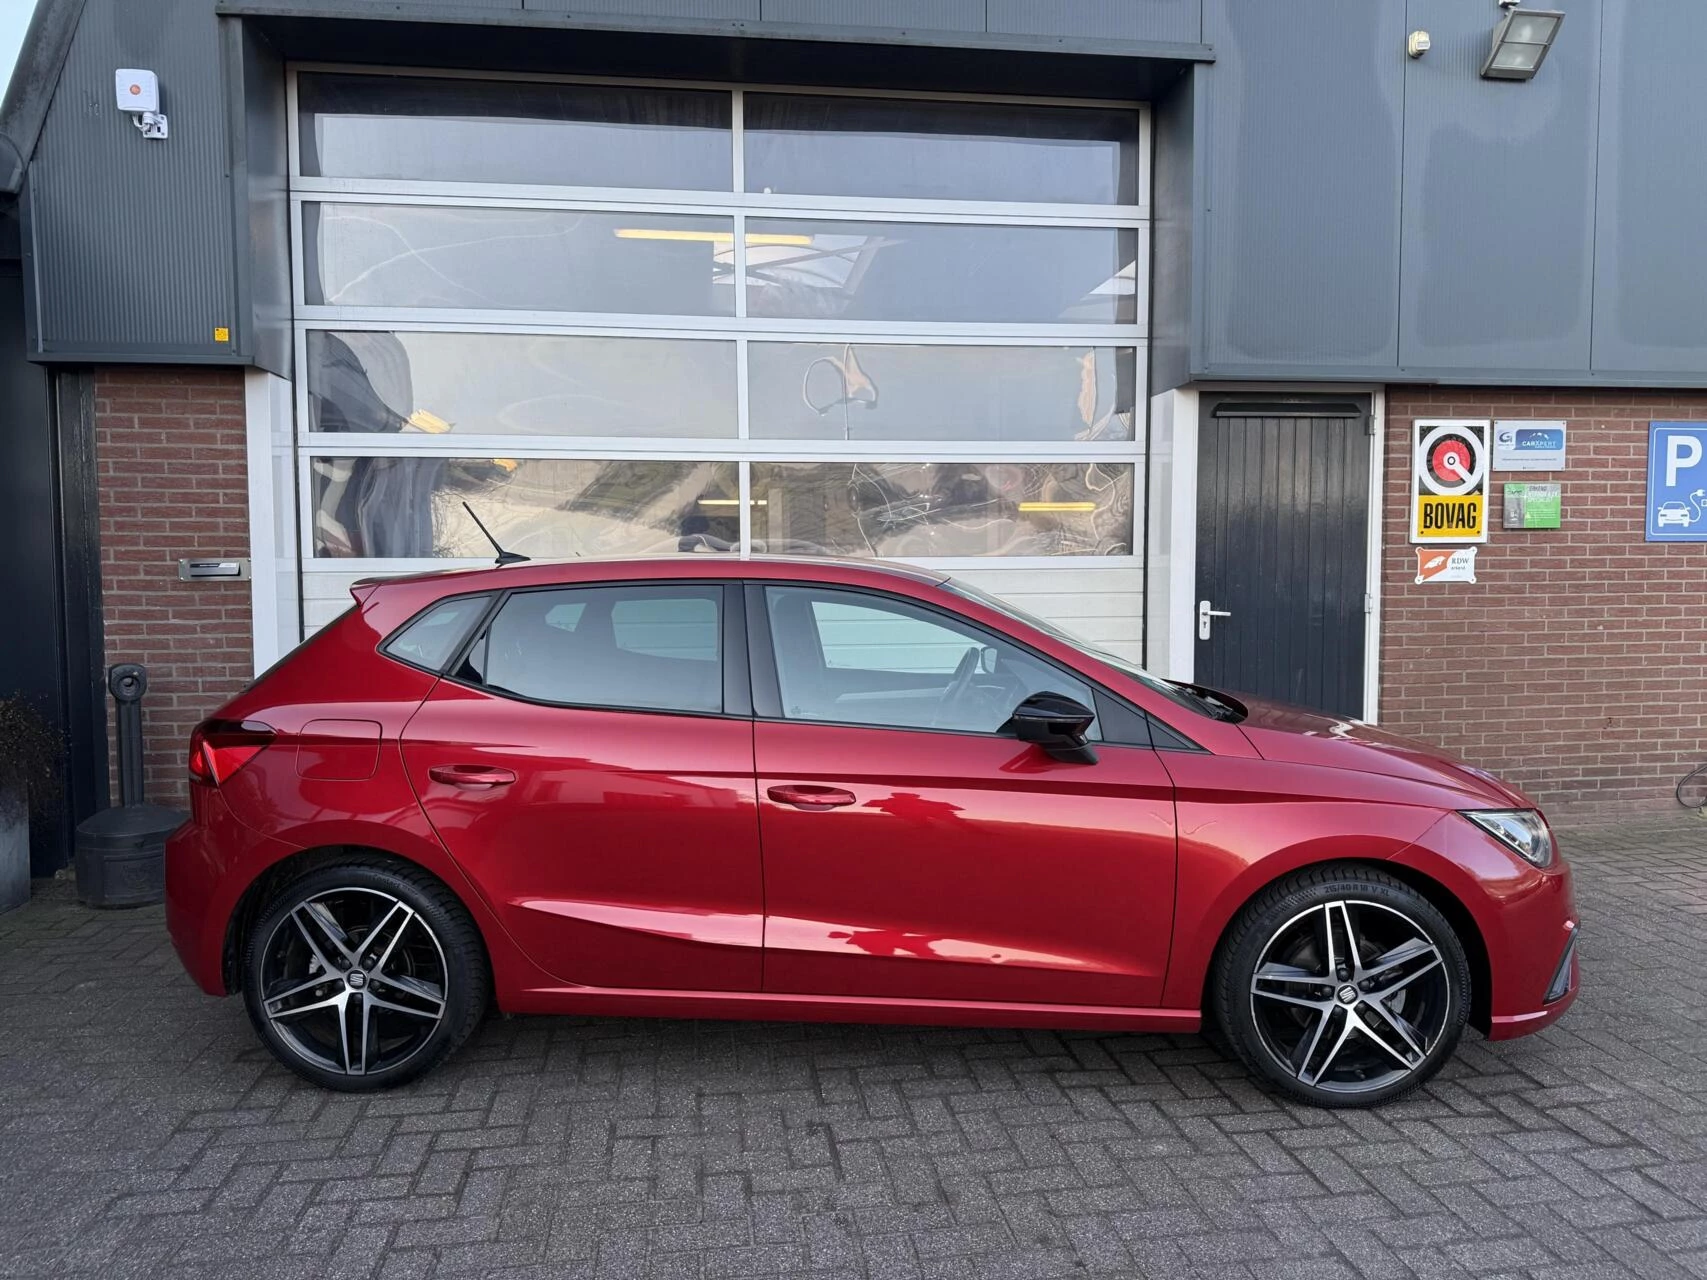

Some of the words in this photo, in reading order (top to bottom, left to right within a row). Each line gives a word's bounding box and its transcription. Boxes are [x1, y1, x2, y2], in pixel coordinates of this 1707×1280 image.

[1666, 435, 1702, 486] P
[1423, 502, 1477, 529] BOVAG
[1451, 557, 1470, 565] RDW
[1325, 883, 1351, 894] 215/40
[1360, 884, 1369, 892] 18
[1381, 888, 1389, 896] XL
